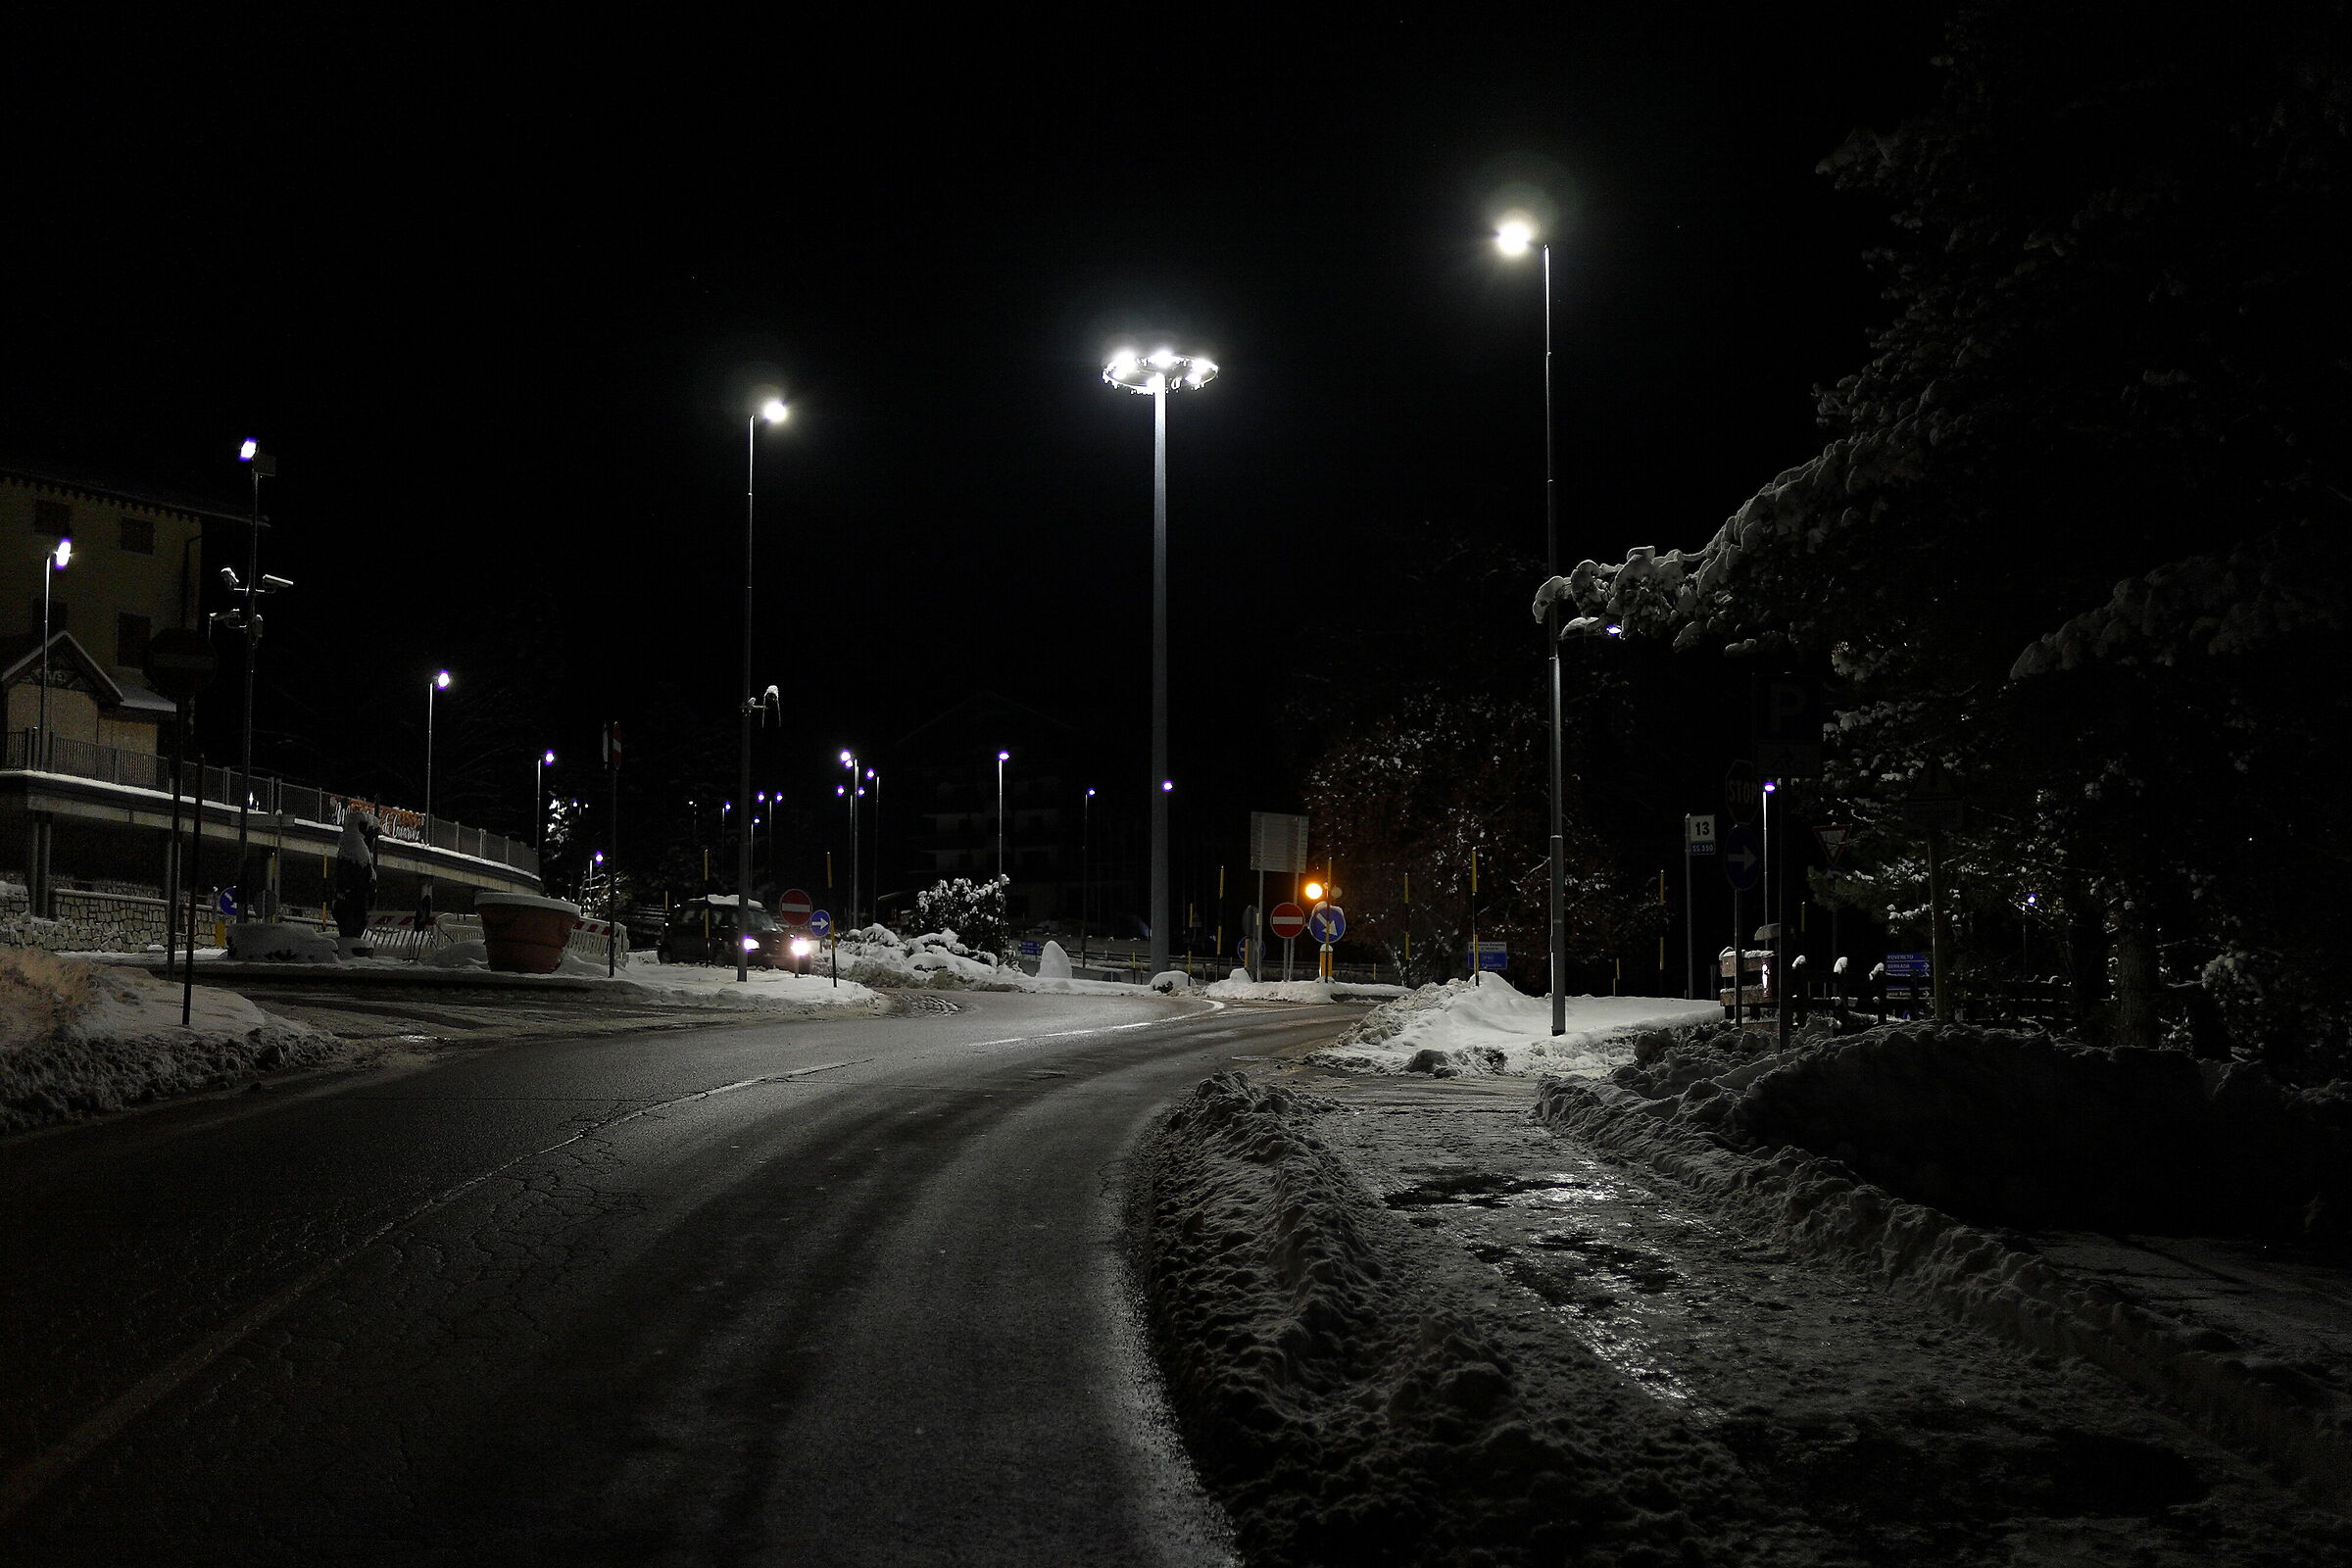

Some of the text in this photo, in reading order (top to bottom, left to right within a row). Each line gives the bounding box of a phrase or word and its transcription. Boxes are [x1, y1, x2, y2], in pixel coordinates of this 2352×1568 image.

[1771, 683, 1808, 733] P
[1728, 780, 1758, 805] STOP
[1695, 821, 1709, 836] 13
